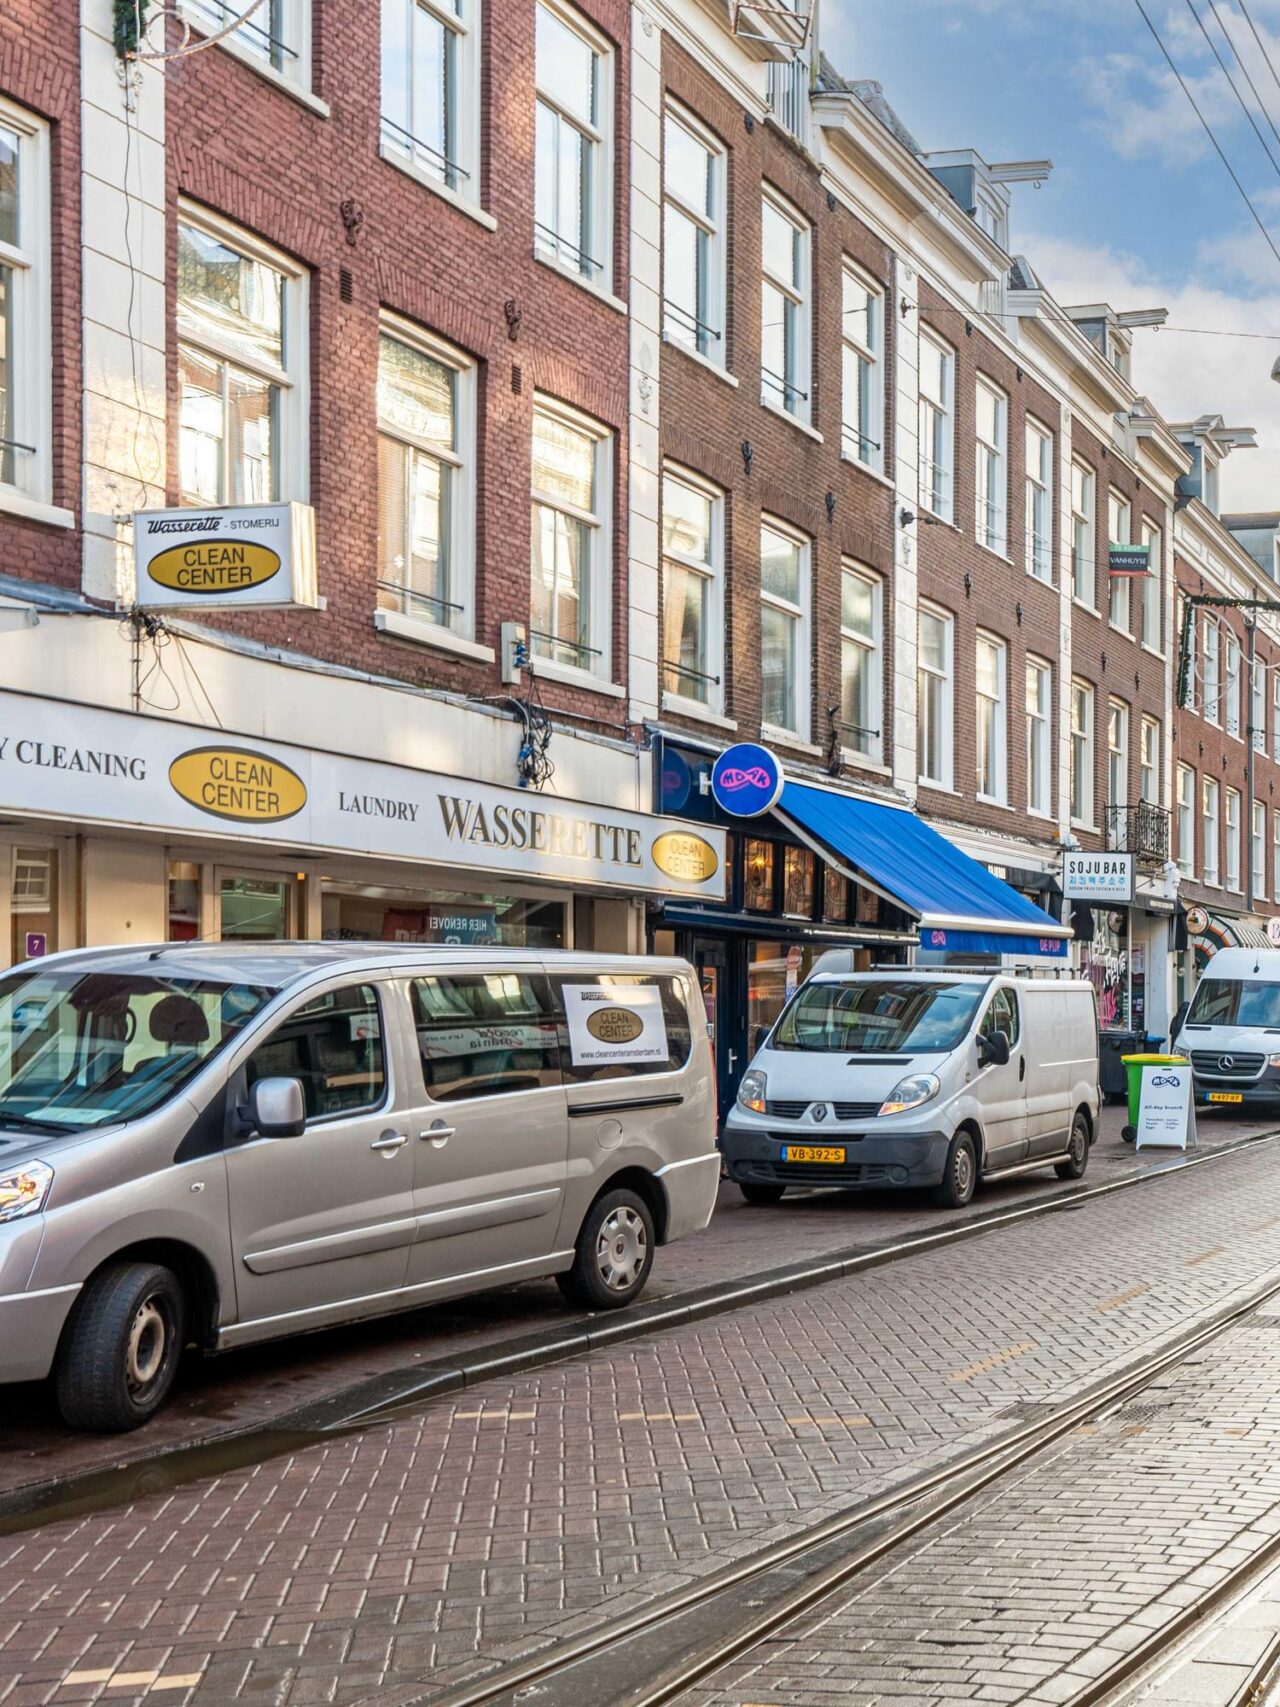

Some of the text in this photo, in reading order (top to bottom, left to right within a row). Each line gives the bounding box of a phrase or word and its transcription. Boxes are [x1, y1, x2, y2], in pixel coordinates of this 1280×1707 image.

[147, 517, 224, 534] Wasserette
[230, 518, 280, 530] STOMERIJ
[183, 547, 245, 567] CLEAN
[177, 566, 252, 586] CENTER
[16, 739, 146, 781] CLEANING
[209, 756, 273, 788] CLEAN
[201, 782, 280, 815] CENTER
[338, 791, 419, 823] LAUNDRY
[437, 794, 644, 868] WASSERETTE
[669, 838, 702, 858] CLEAN
[665, 856, 705, 875] CENTER
[33, 939, 40, 951] 7
[601, 1012, 629, 1024] CLEAN
[599, 1025, 633, 1038] CENTER
[791, 1148, 841, 1161] VB-392-S
